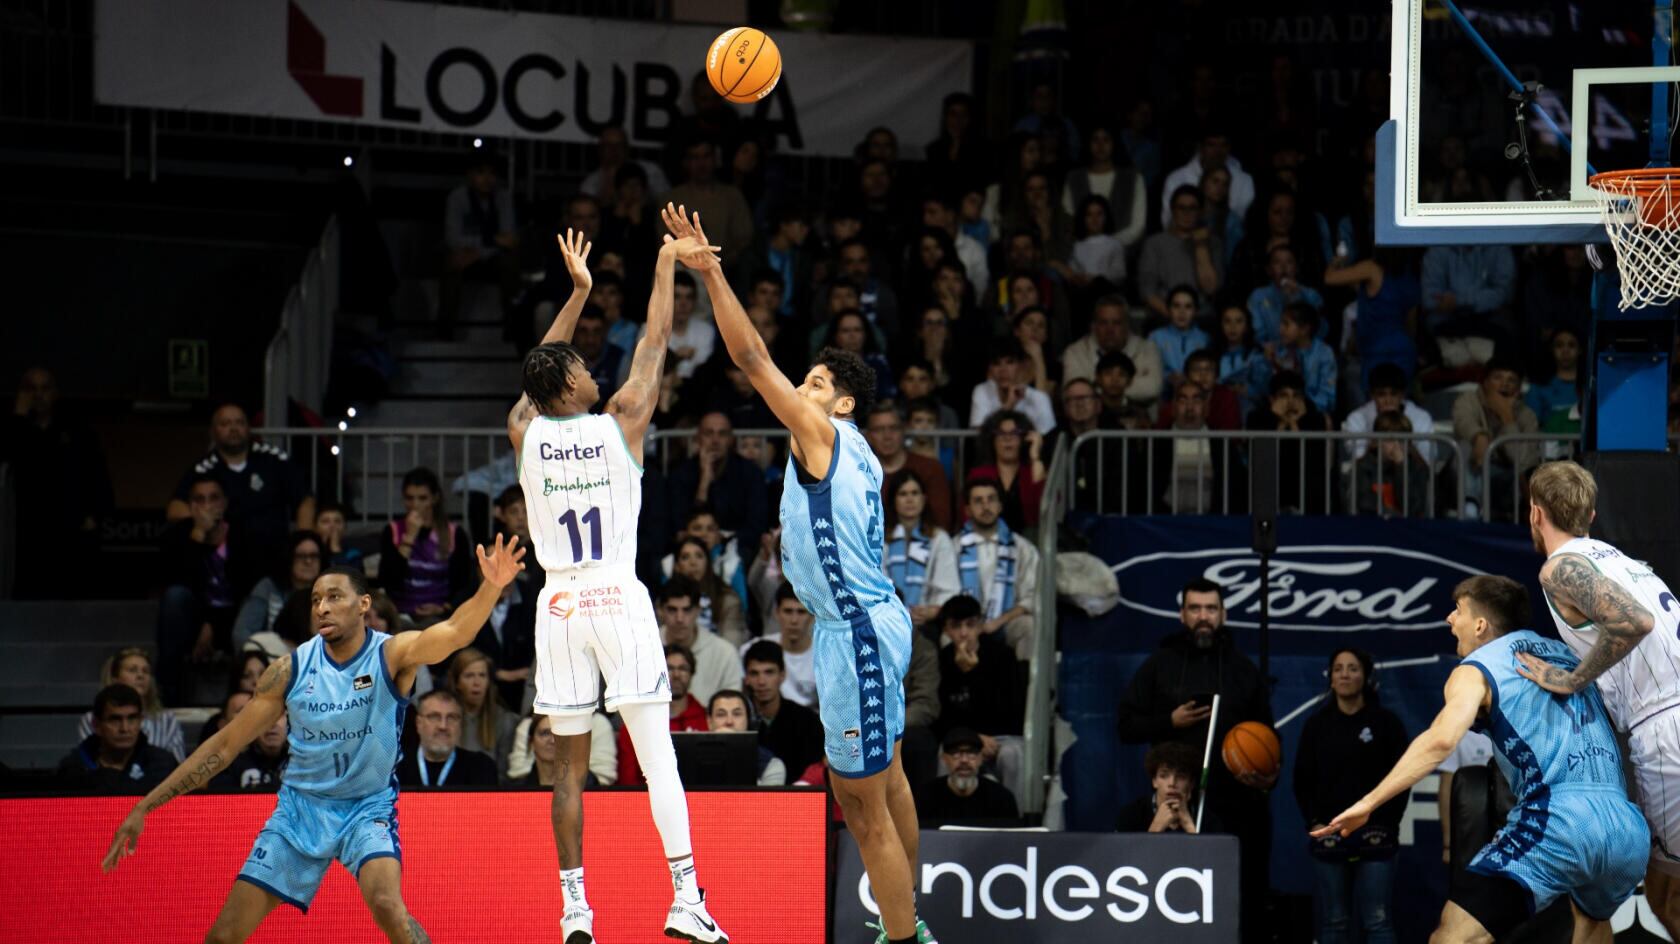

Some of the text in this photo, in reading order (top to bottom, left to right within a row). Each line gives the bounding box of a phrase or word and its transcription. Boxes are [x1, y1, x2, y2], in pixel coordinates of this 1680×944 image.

[379, 41, 805, 149] LOCUBA
[540, 442, 604, 461] Carter
[559, 507, 602, 563] 11
[579, 598, 624, 608] DEL SOL
[580, 587, 622, 598] COSTA
[1176, 559, 1438, 620] Ford
